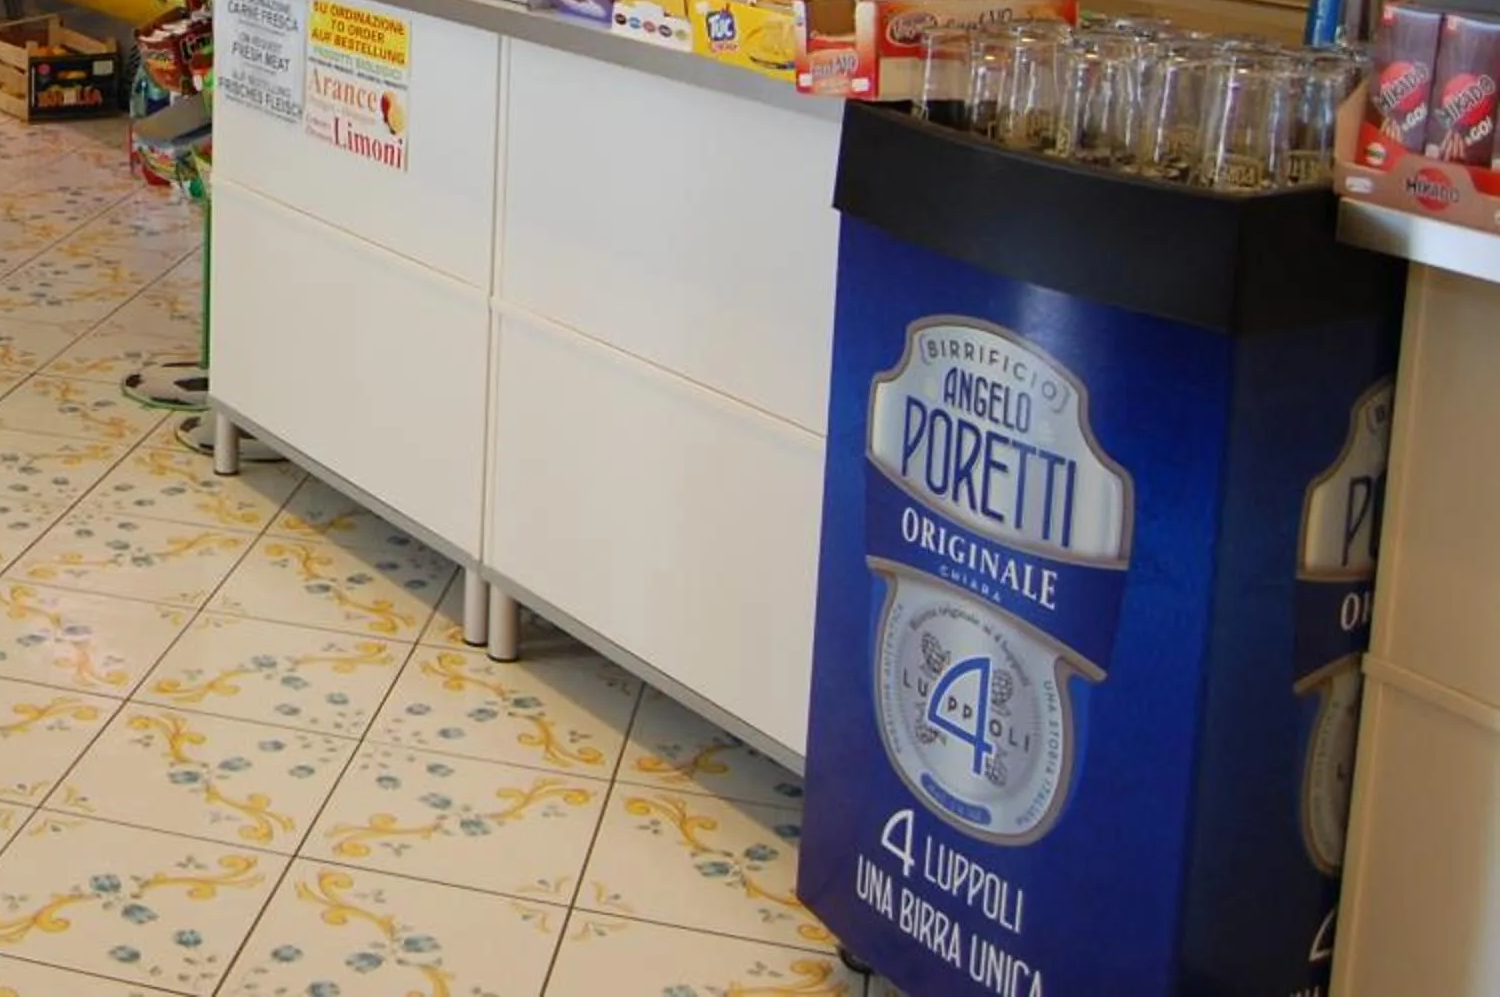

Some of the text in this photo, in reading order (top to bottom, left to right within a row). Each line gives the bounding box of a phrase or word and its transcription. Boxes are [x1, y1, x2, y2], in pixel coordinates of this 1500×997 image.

[330, 4, 405, 35] ORDINAZIONE
[348, 24, 385, 42] ORDER
[335, 33, 405, 65] BESTELLUNG
[308, 68, 378, 114] Arance
[333, 116, 404, 169] Limoni
[1405, 177, 1461, 203] MIKADO
[944, 367, 1032, 433] ANGELO
[902, 395, 1077, 548] PORETTI
[902, 506, 1058, 610] ORIGINALE
[939, 565, 1001, 603] CHIARA
[881, 809, 1023, 934] 4 LUPPOLI
[857, 855, 1042, 997] UNA BIRRA UNICA
